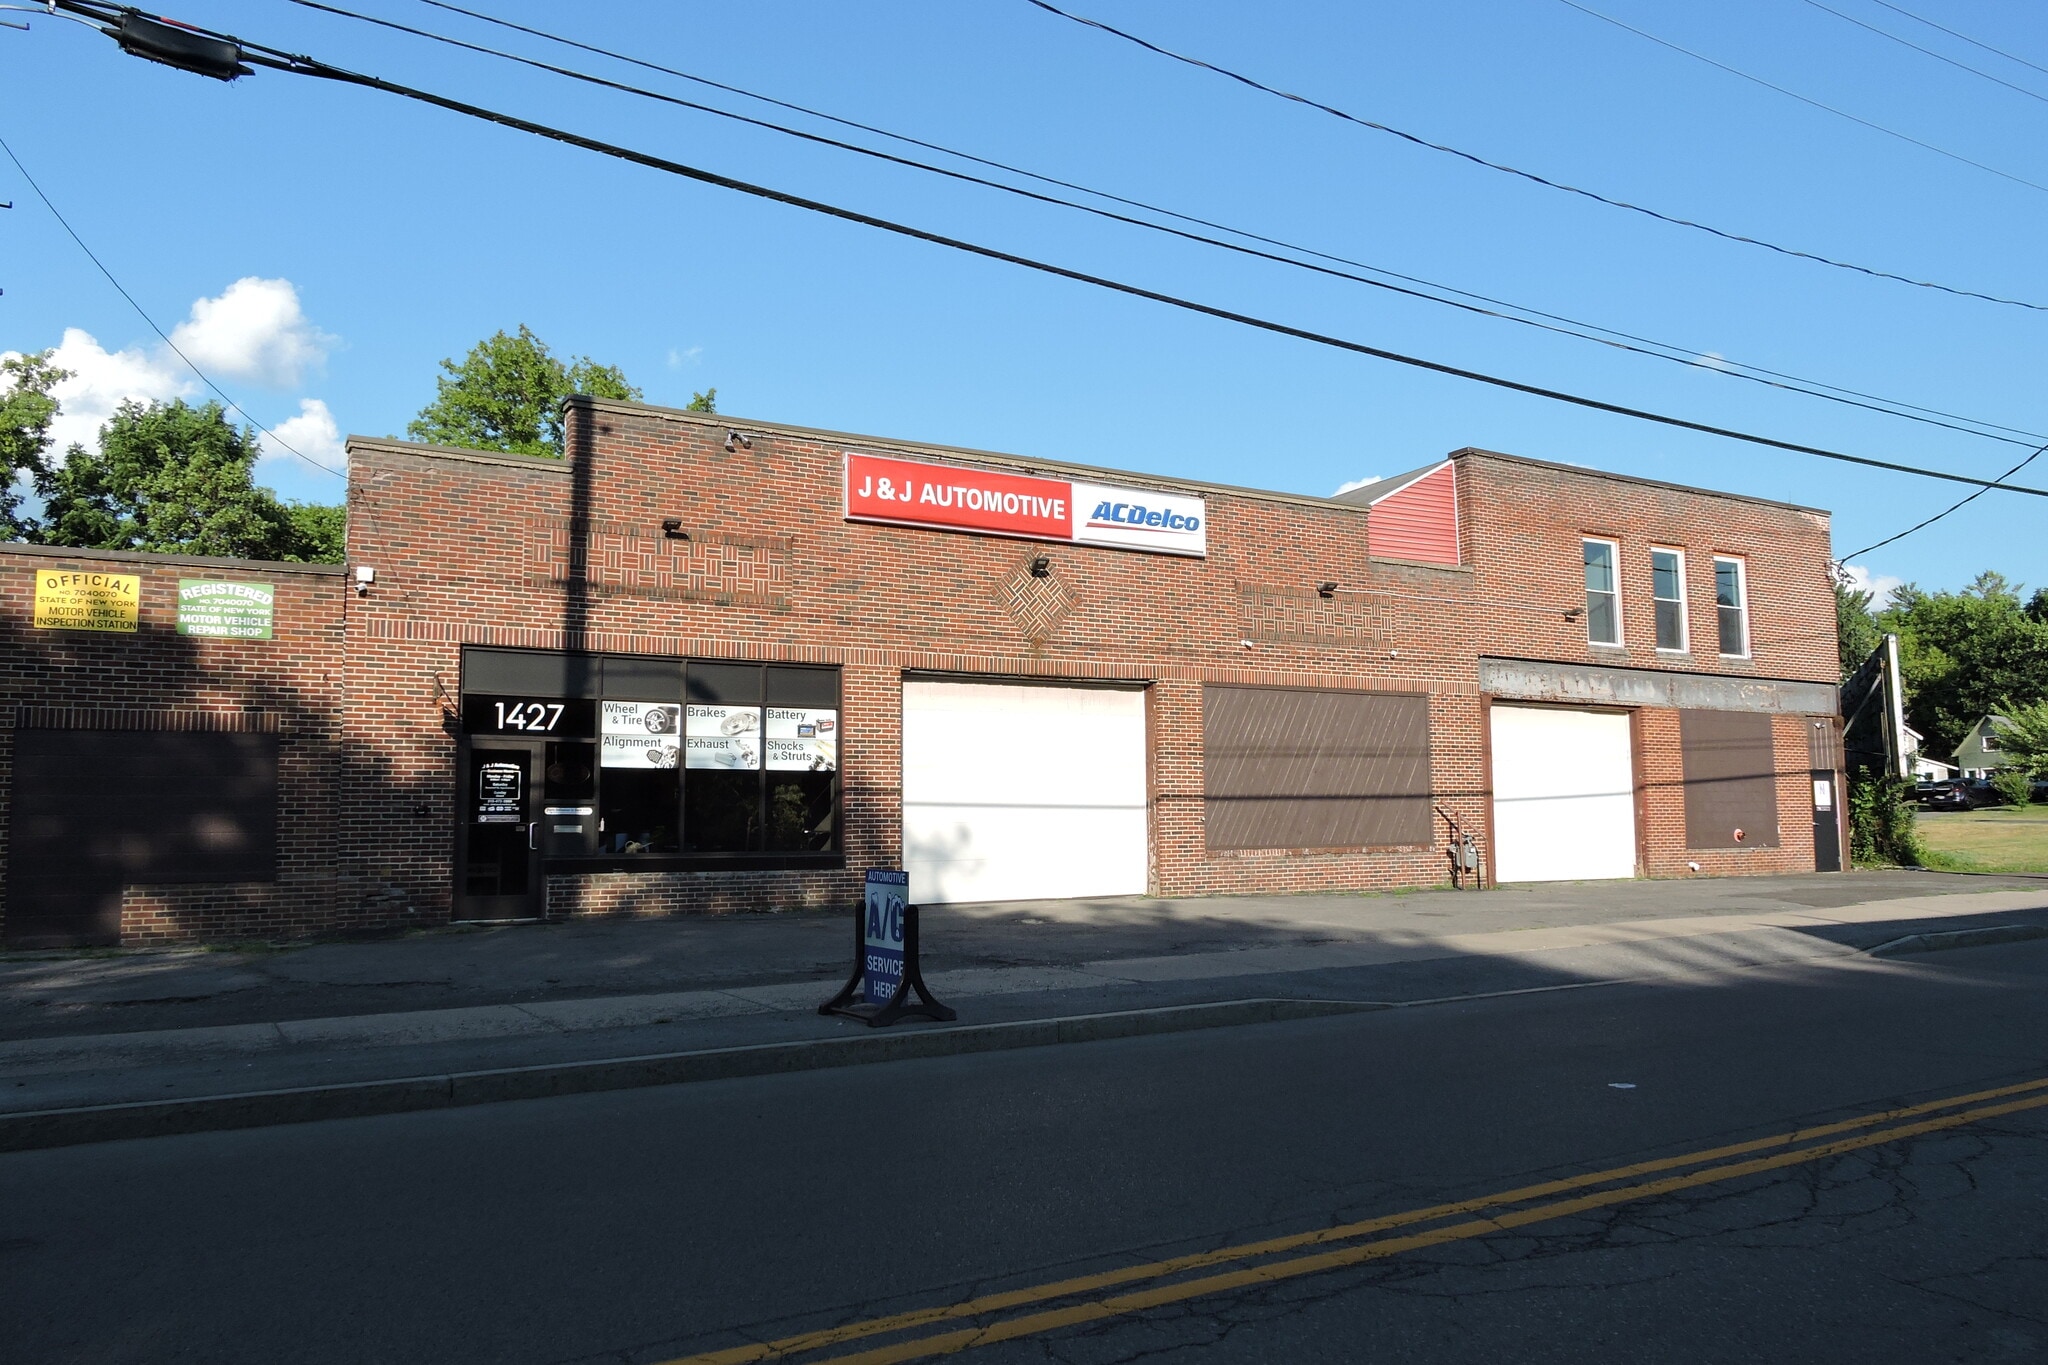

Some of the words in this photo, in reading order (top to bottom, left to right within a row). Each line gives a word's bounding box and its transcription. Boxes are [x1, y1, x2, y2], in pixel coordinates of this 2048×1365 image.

[858, 476, 871, 498] J
[878, 477, 896, 500] &
[899, 480, 912, 502] J
[920, 482, 1066, 520] AUTOMOTIVE
[1091, 501, 1200, 532] ACDelco
[47, 574, 130, 594] OFFICIAL
[40, 596, 67, 604] STATE
[181, 584, 273, 605] REGISTERED
[213, 598, 254, 606] 7040070
[49, 606, 84, 616] MOTOR
[86, 608, 126, 618] VEHICLE
[36, 617, 94, 628] INSPECTION
[97, 619, 136, 630] STATION
[180, 614, 221, 624] MOTOR
[224, 616, 271, 626] VEHICLE
[188, 625, 228, 635] REPAIR
[230, 627, 262, 636] SHOP
[603, 703, 638, 714] Wheel
[688, 707, 726, 718] Brakes
[495, 702, 565, 731] 1427
[621, 715, 643, 725] Tire
[768, 709, 806, 722] Battery
[603, 736, 662, 748] Alignment
[687, 739, 729, 749] Exhaust
[768, 741, 804, 751] Shocks
[781, 751, 812, 761] Struts
[868, 871, 906, 884] AUTOMOTIVE
[867, 892, 905, 942] A/C
[867, 954, 904, 976] SERVICE
